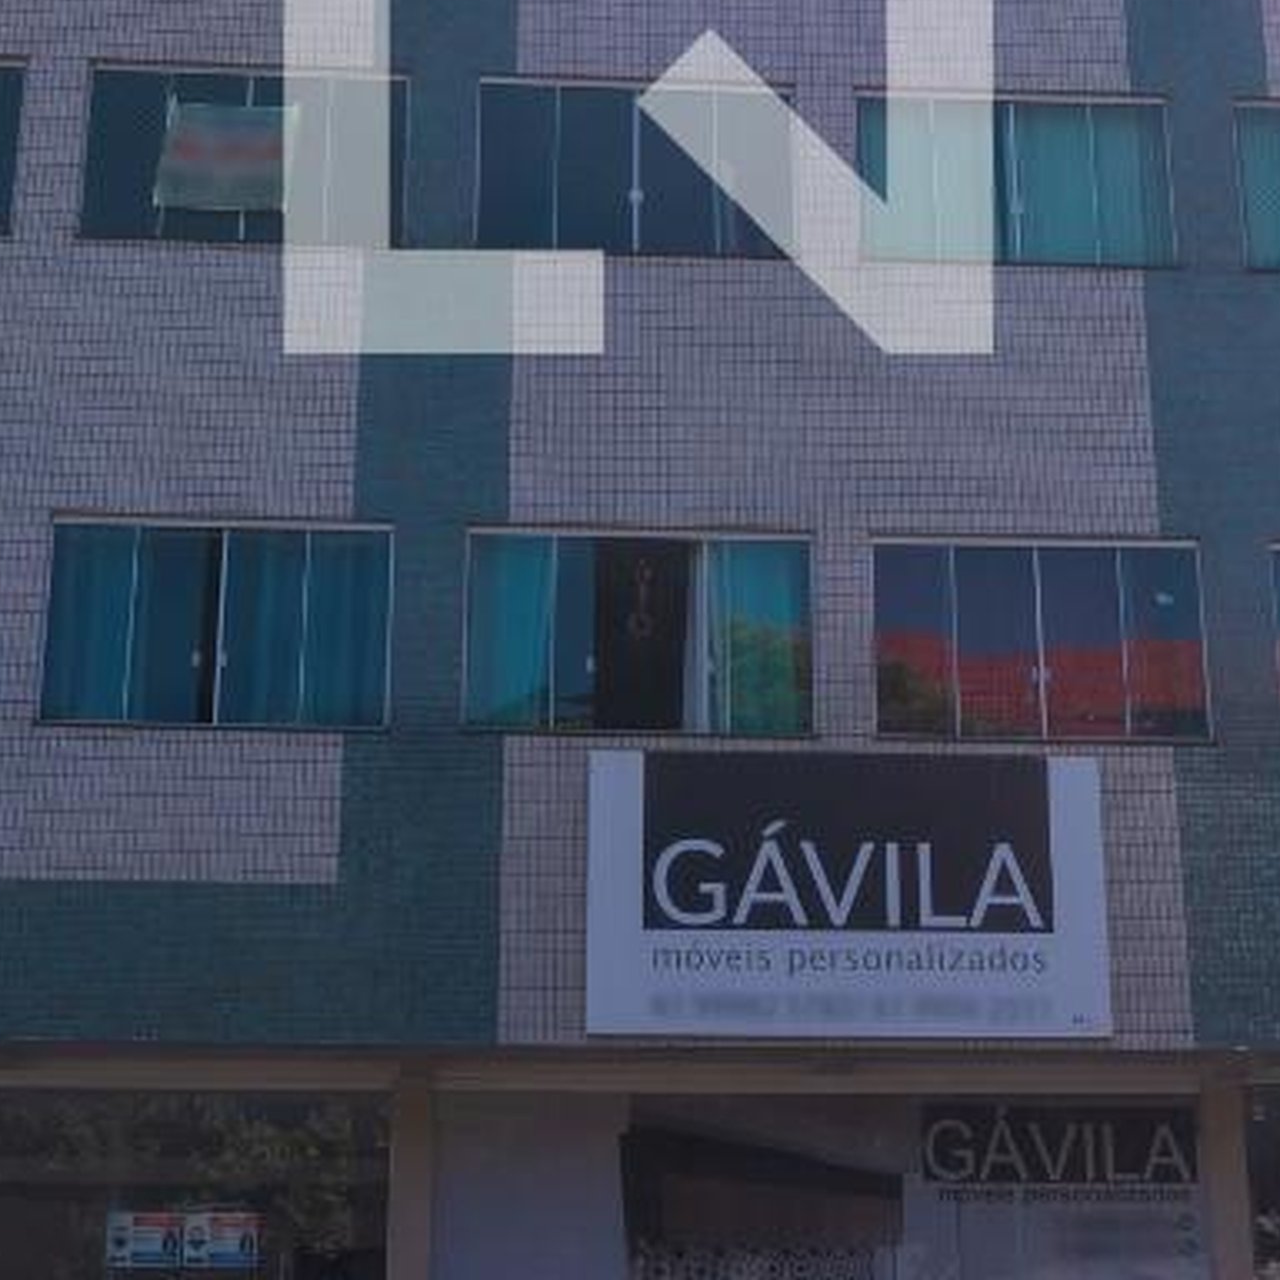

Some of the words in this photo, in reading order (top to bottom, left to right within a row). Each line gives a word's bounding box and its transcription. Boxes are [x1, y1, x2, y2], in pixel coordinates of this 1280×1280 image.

[651, 820, 1045, 928] GÁVILA
[651, 943, 771, 974] móveis
[788, 942, 1048, 978] personalizados
[926, 1106, 1192, 1182] GÁVILA
